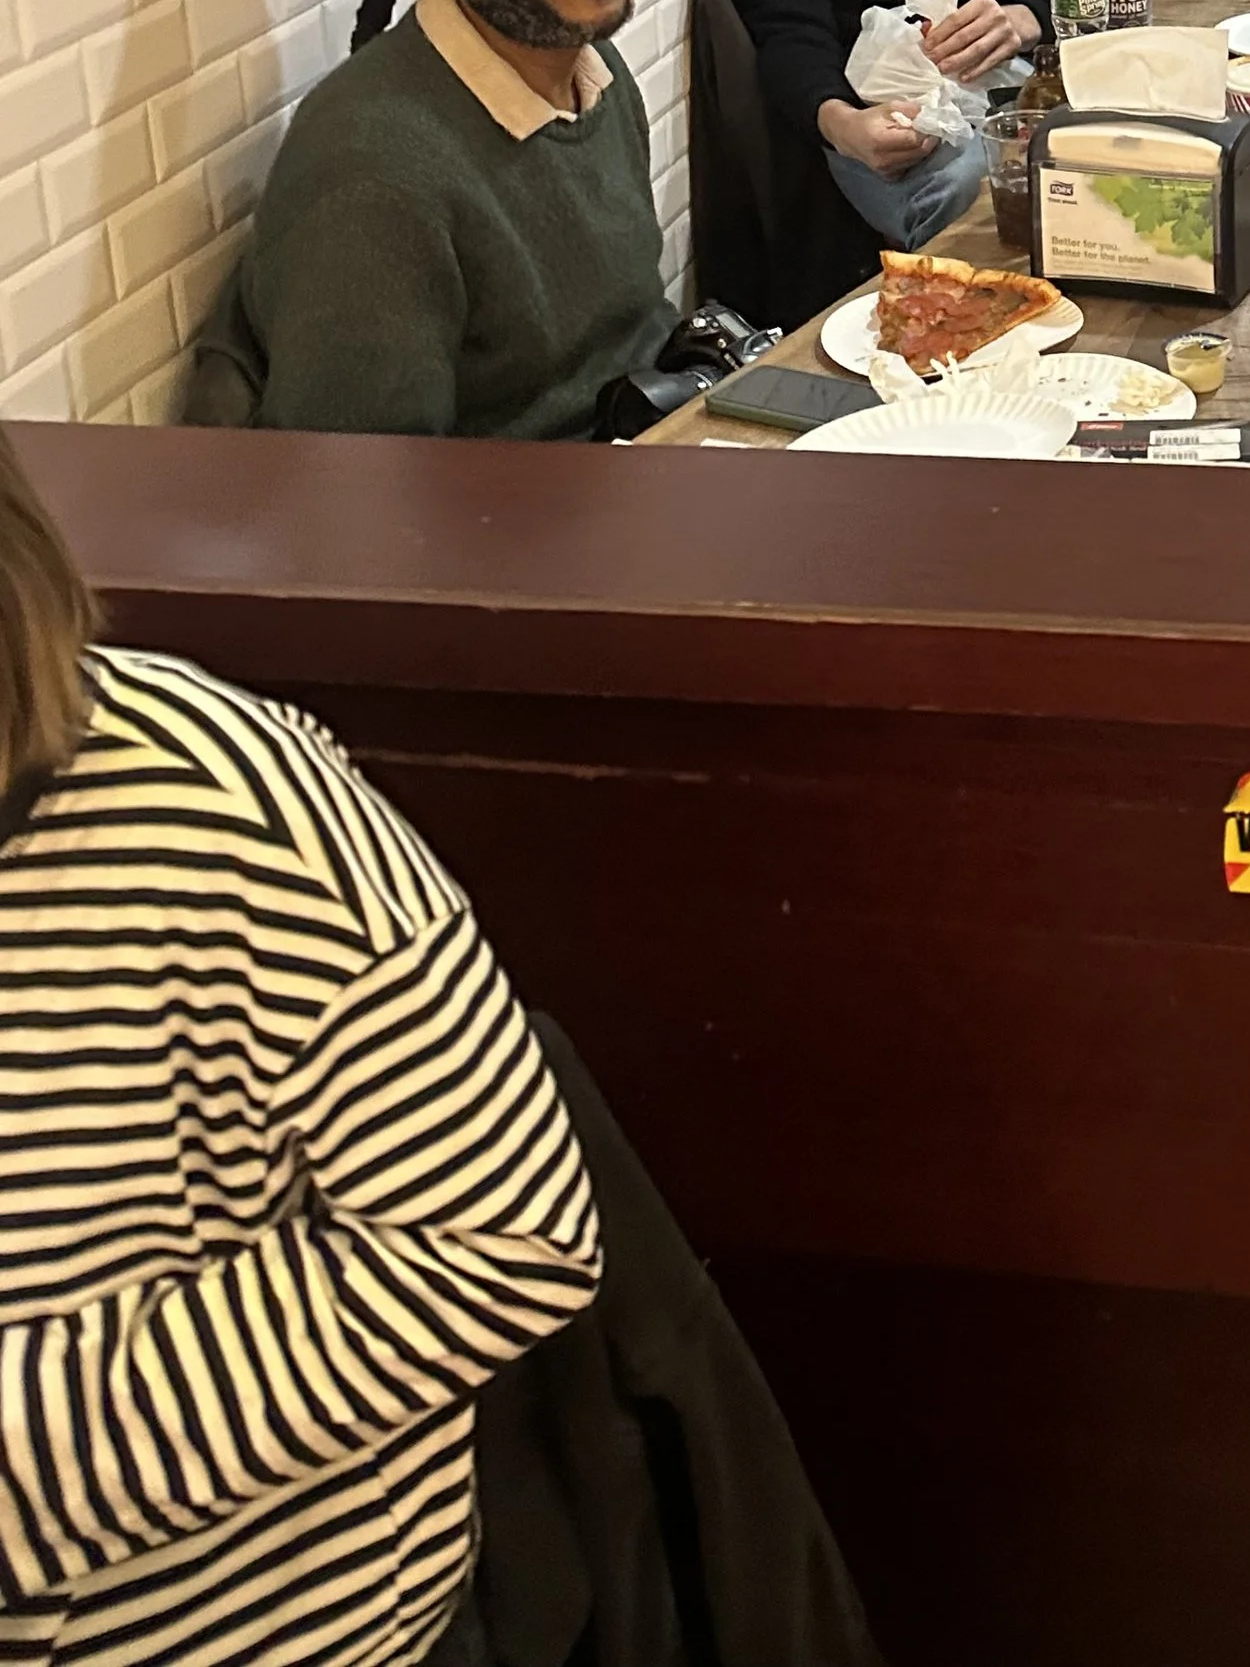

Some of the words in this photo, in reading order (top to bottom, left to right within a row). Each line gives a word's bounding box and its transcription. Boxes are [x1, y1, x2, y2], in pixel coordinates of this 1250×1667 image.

[1111, 0, 1148, 14] HONEY
[1051, 236, 1081, 247] Better
[1083, 239, 1098, 249] for
[1051, 246, 1081, 258] Better
[1084, 250, 1098, 260] for
